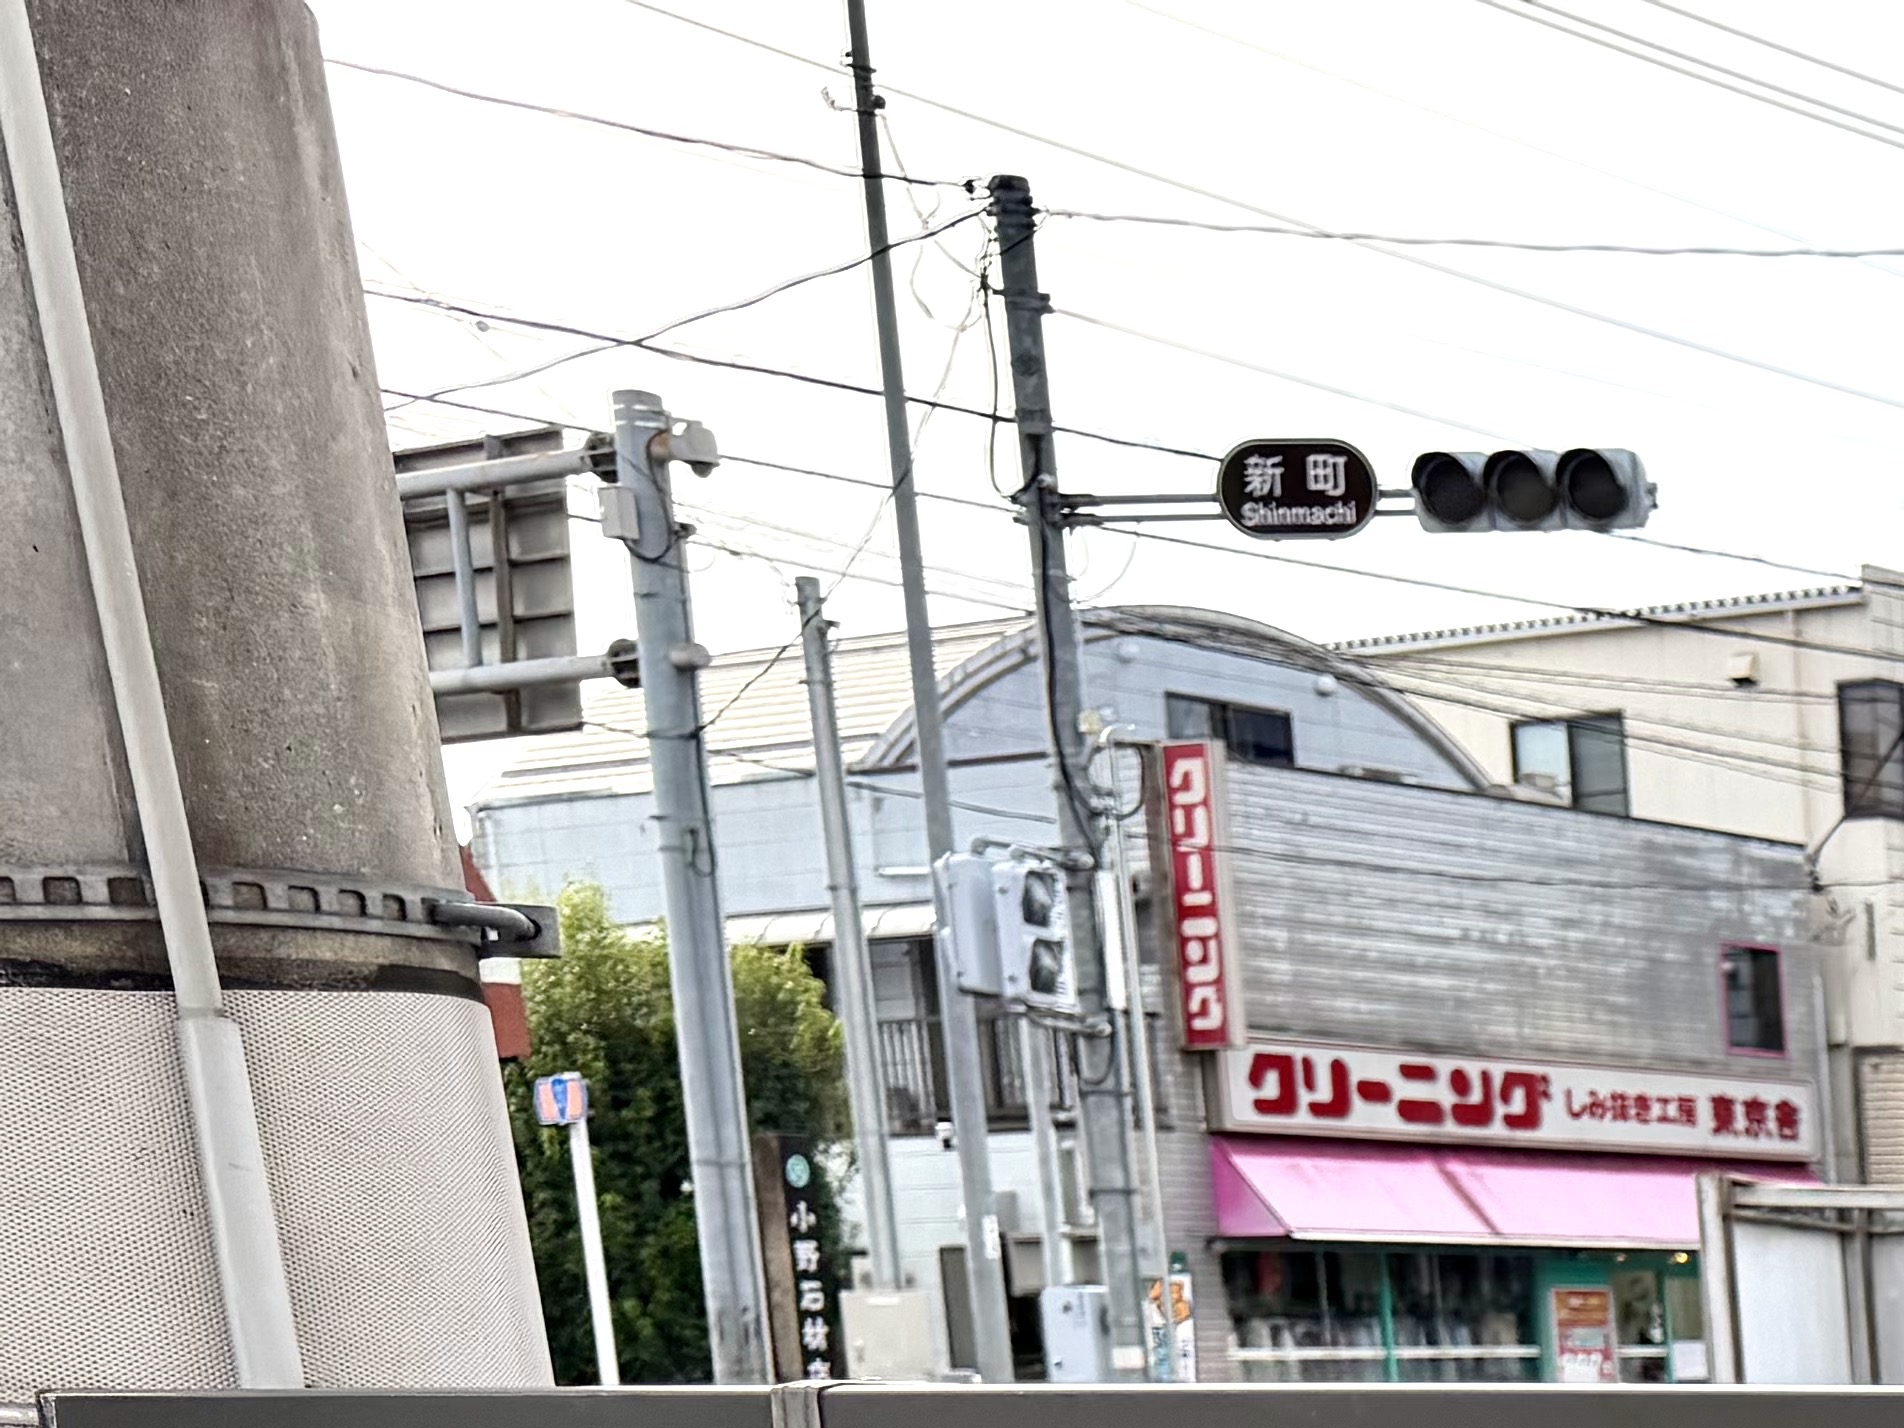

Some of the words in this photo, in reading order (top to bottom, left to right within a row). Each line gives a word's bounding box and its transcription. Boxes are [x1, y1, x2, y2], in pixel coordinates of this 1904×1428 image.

[1243, 454, 1347, 498] 新町
[1241, 501, 1356, 525] Shinmachi
[1169, 756, 1225, 1032] クリーニング
[1249, 1052, 1551, 1131] クリーニング
